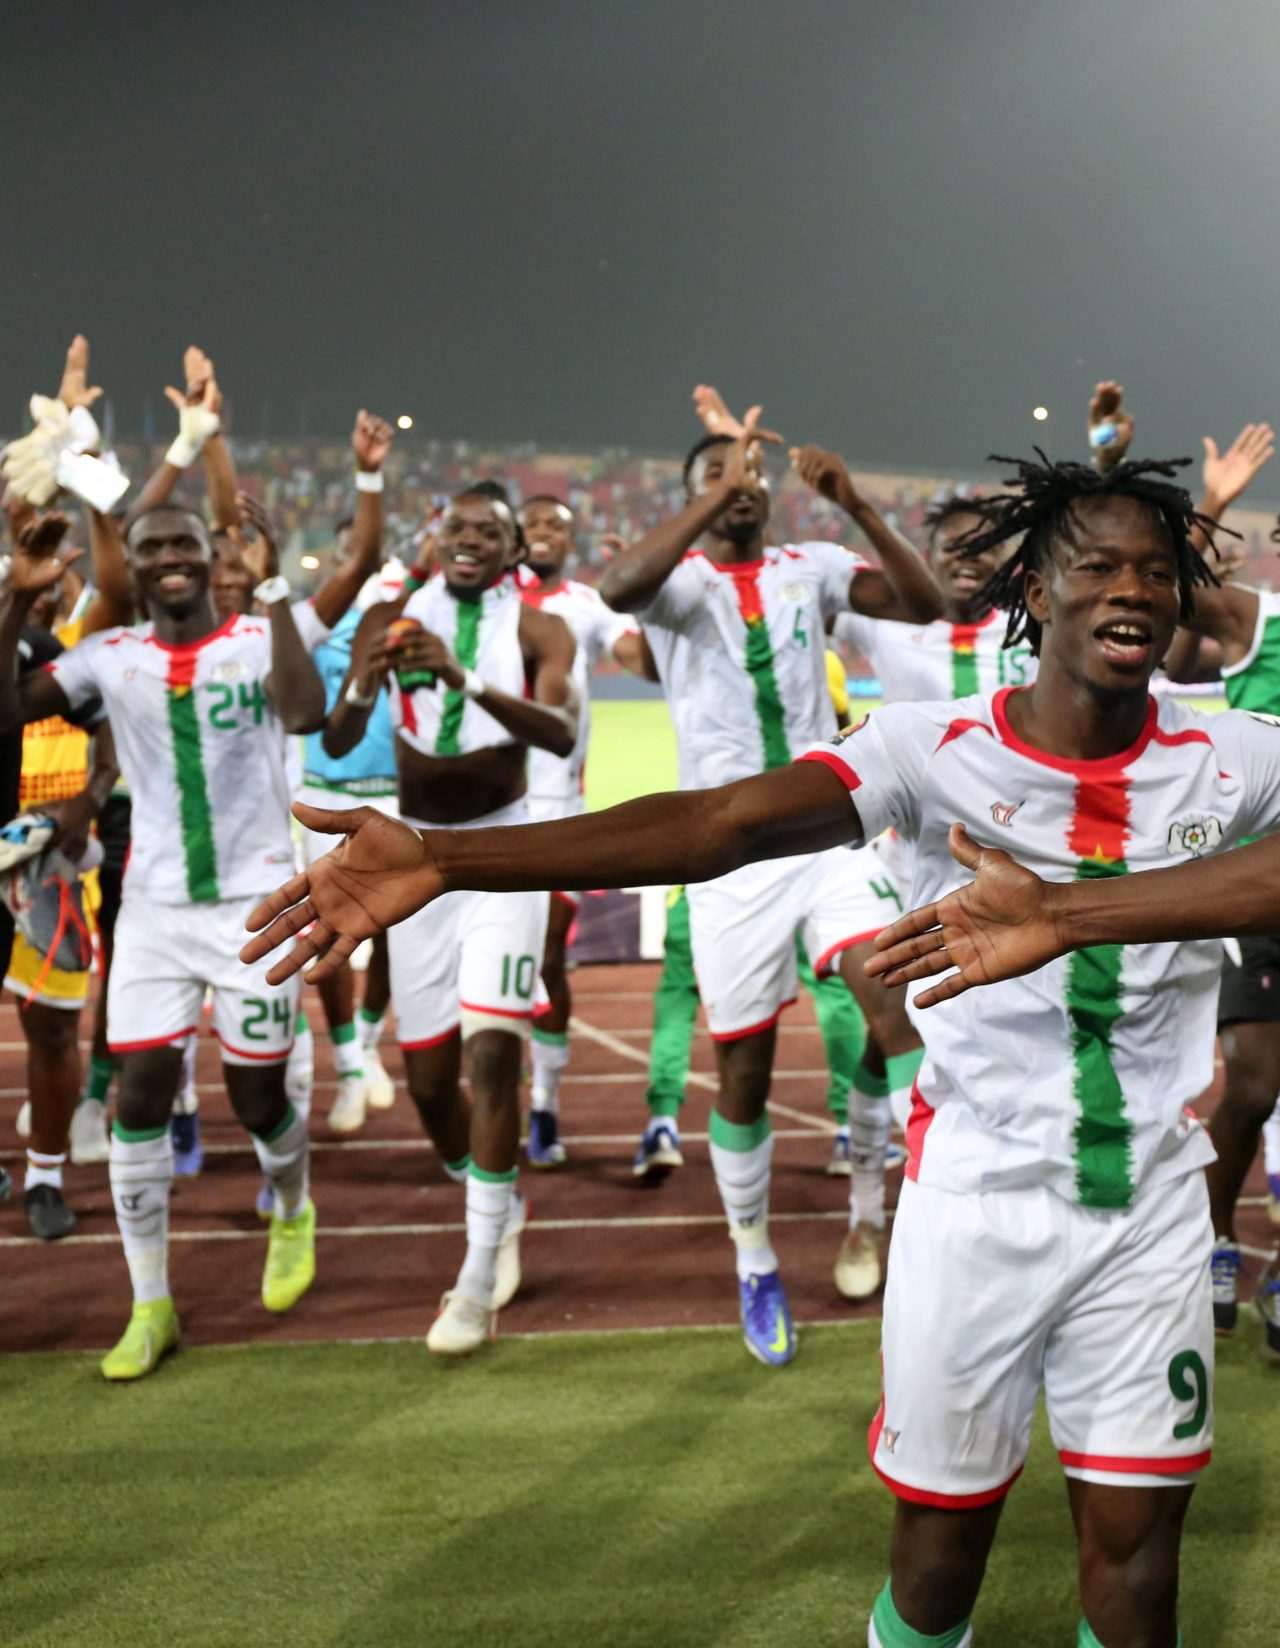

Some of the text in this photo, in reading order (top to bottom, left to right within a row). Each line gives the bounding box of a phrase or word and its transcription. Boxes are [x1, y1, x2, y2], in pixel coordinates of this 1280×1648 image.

[793, 606, 808, 649] 4
[998, 646, 1030, 686] 15
[207, 678, 267, 730] 24
[869, 877, 904, 913] 4
[501, 954, 536, 999] 10
[242, 997, 290, 1040] 24
[1168, 1349, 1207, 1440] 9
